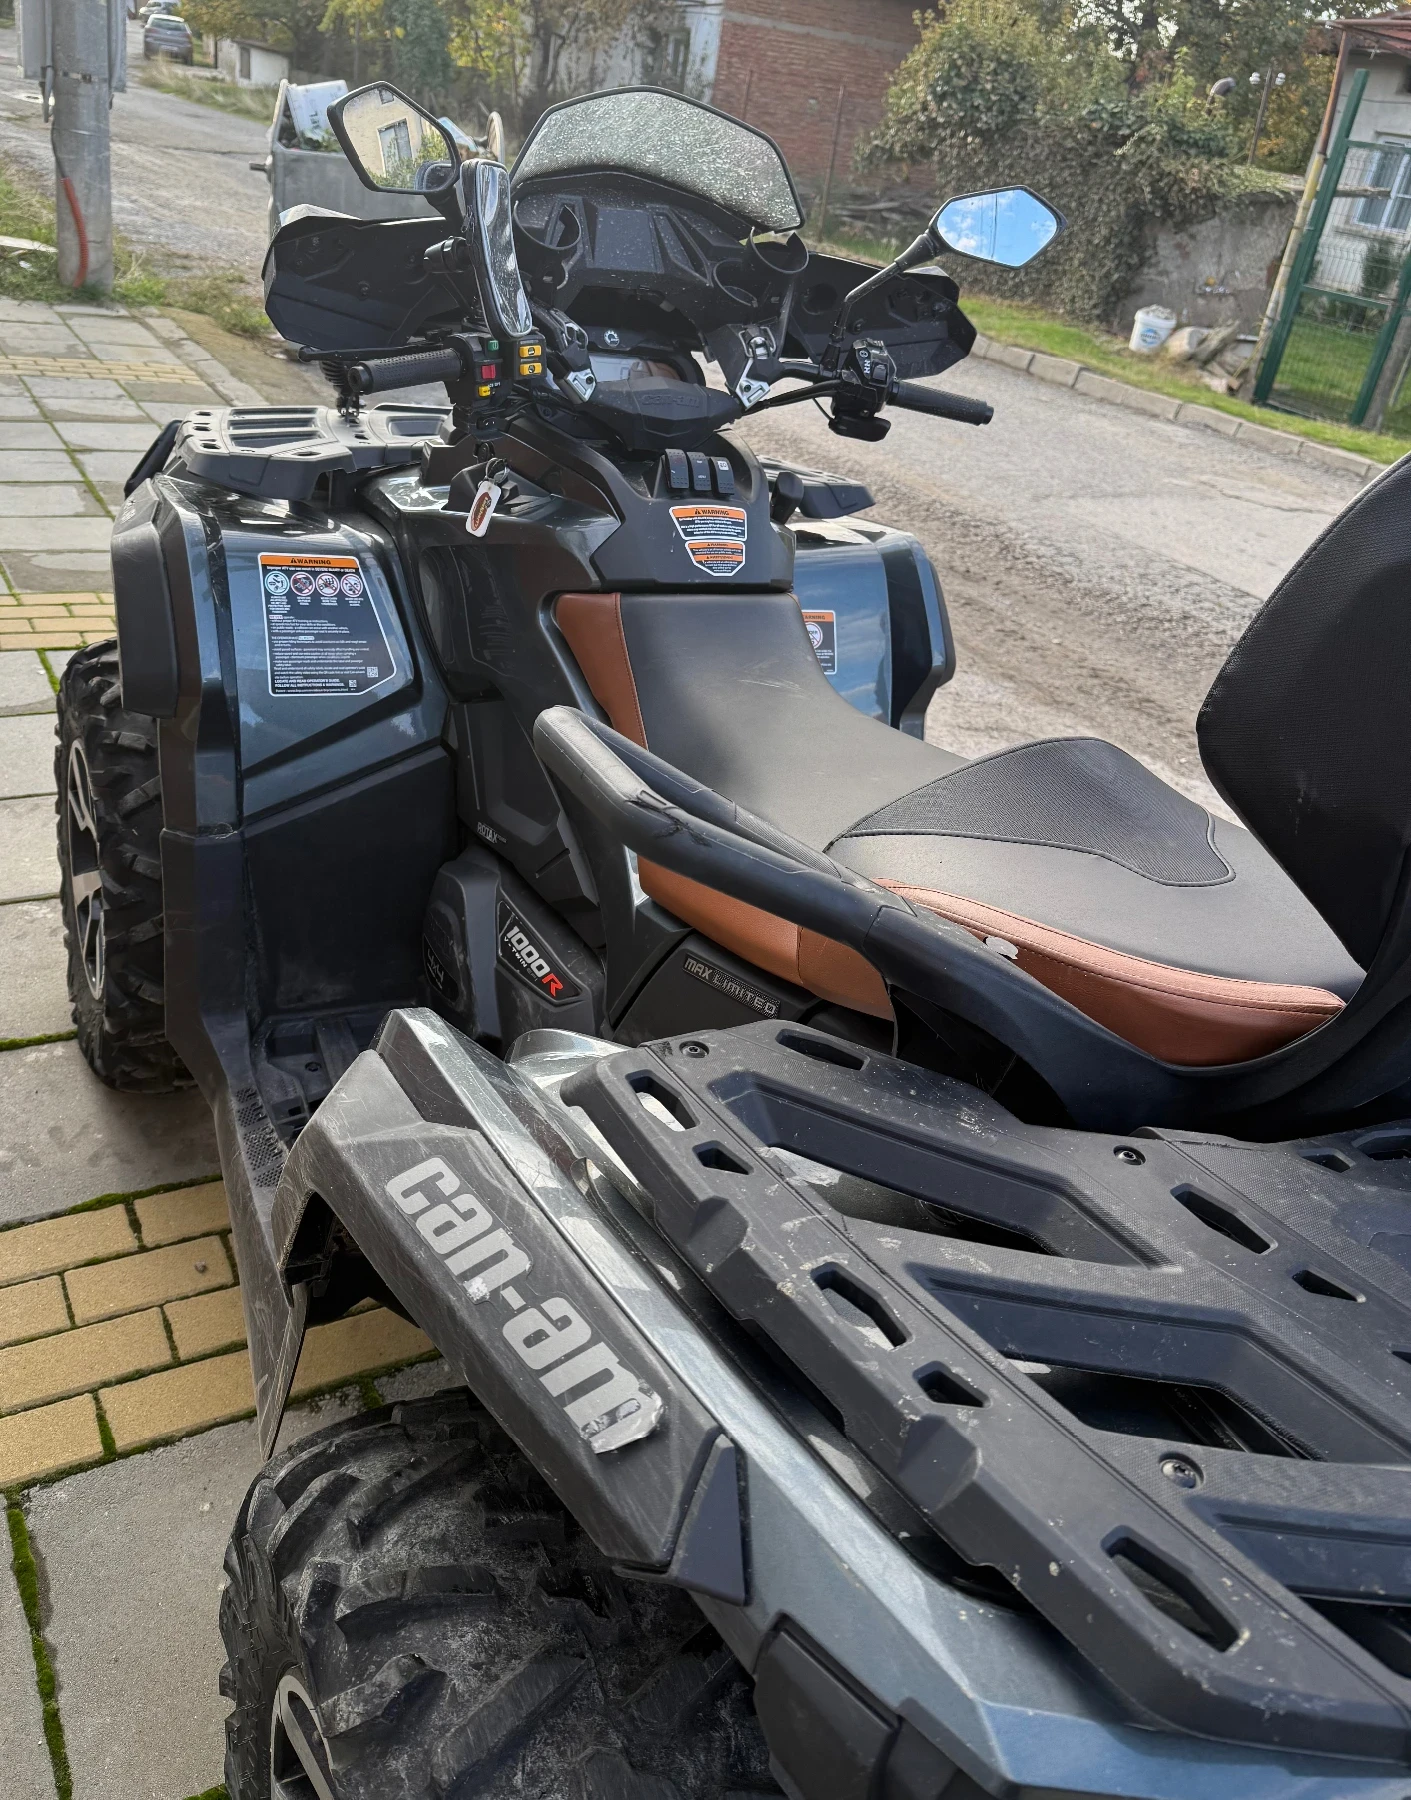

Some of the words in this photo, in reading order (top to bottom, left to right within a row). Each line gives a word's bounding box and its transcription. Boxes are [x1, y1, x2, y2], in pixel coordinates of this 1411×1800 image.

[477, 821, 497, 844] ROTAX
[504, 936, 528, 968] V-TWIN
[506, 926, 564, 997] 1000R
[684, 957, 713, 980] MAX
[713, 973, 776, 1015] LIMITED
[385, 1156, 663, 1454] can-am
